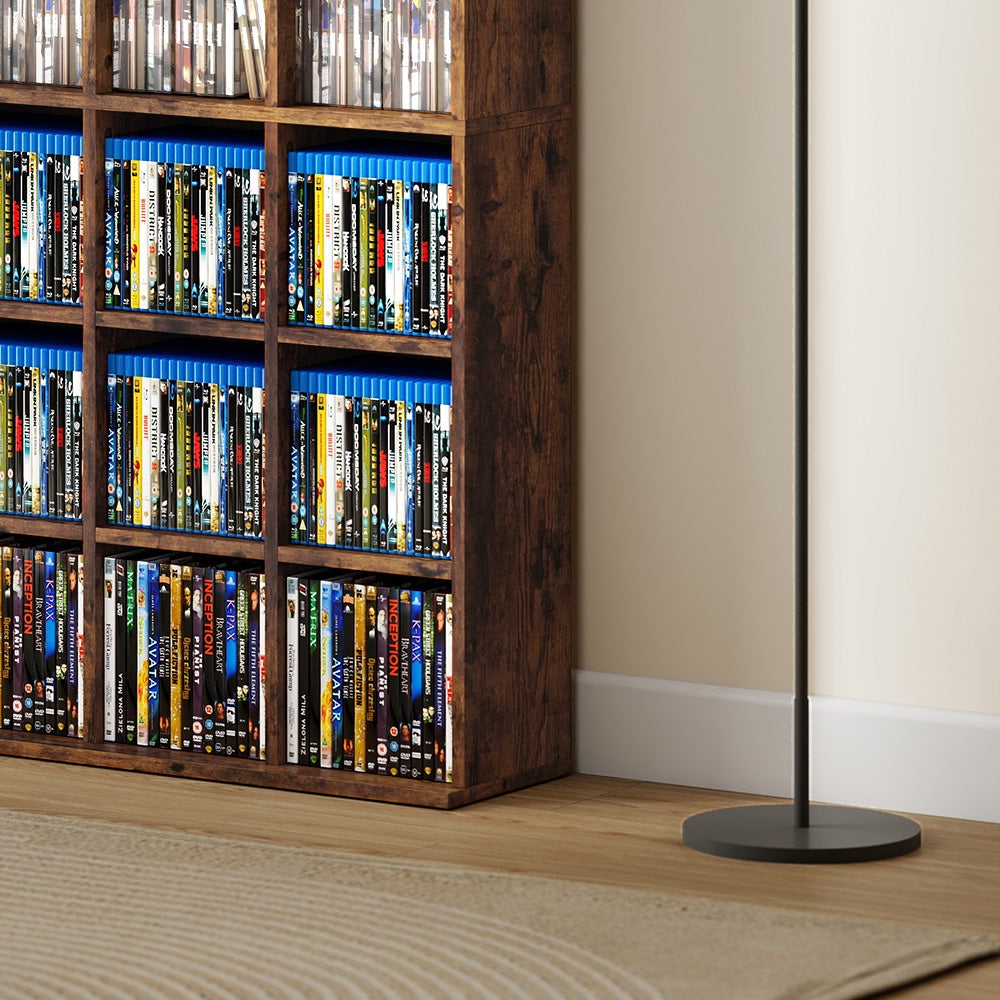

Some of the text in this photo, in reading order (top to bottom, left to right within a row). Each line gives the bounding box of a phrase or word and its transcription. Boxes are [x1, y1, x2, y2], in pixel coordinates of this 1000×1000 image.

[24, 560, 32, 634] INCEPTION
[35, 598, 43, 652] BRAVEHEART
[45, 579, 54, 621] K-PAX
[204, 579, 213, 655] INCEPTION
[226, 599, 235, 641] K-PAX
[216, 618, 224, 673] BRAVEHEART
[389, 599, 398, 676] INCEPTION
[412, 619, 421, 662] K-PAX
[149, 637, 157, 700] AVATAR
[332, 658, 341, 722] AVATAR
[401, 638, 410, 694] BRAVEHEART
